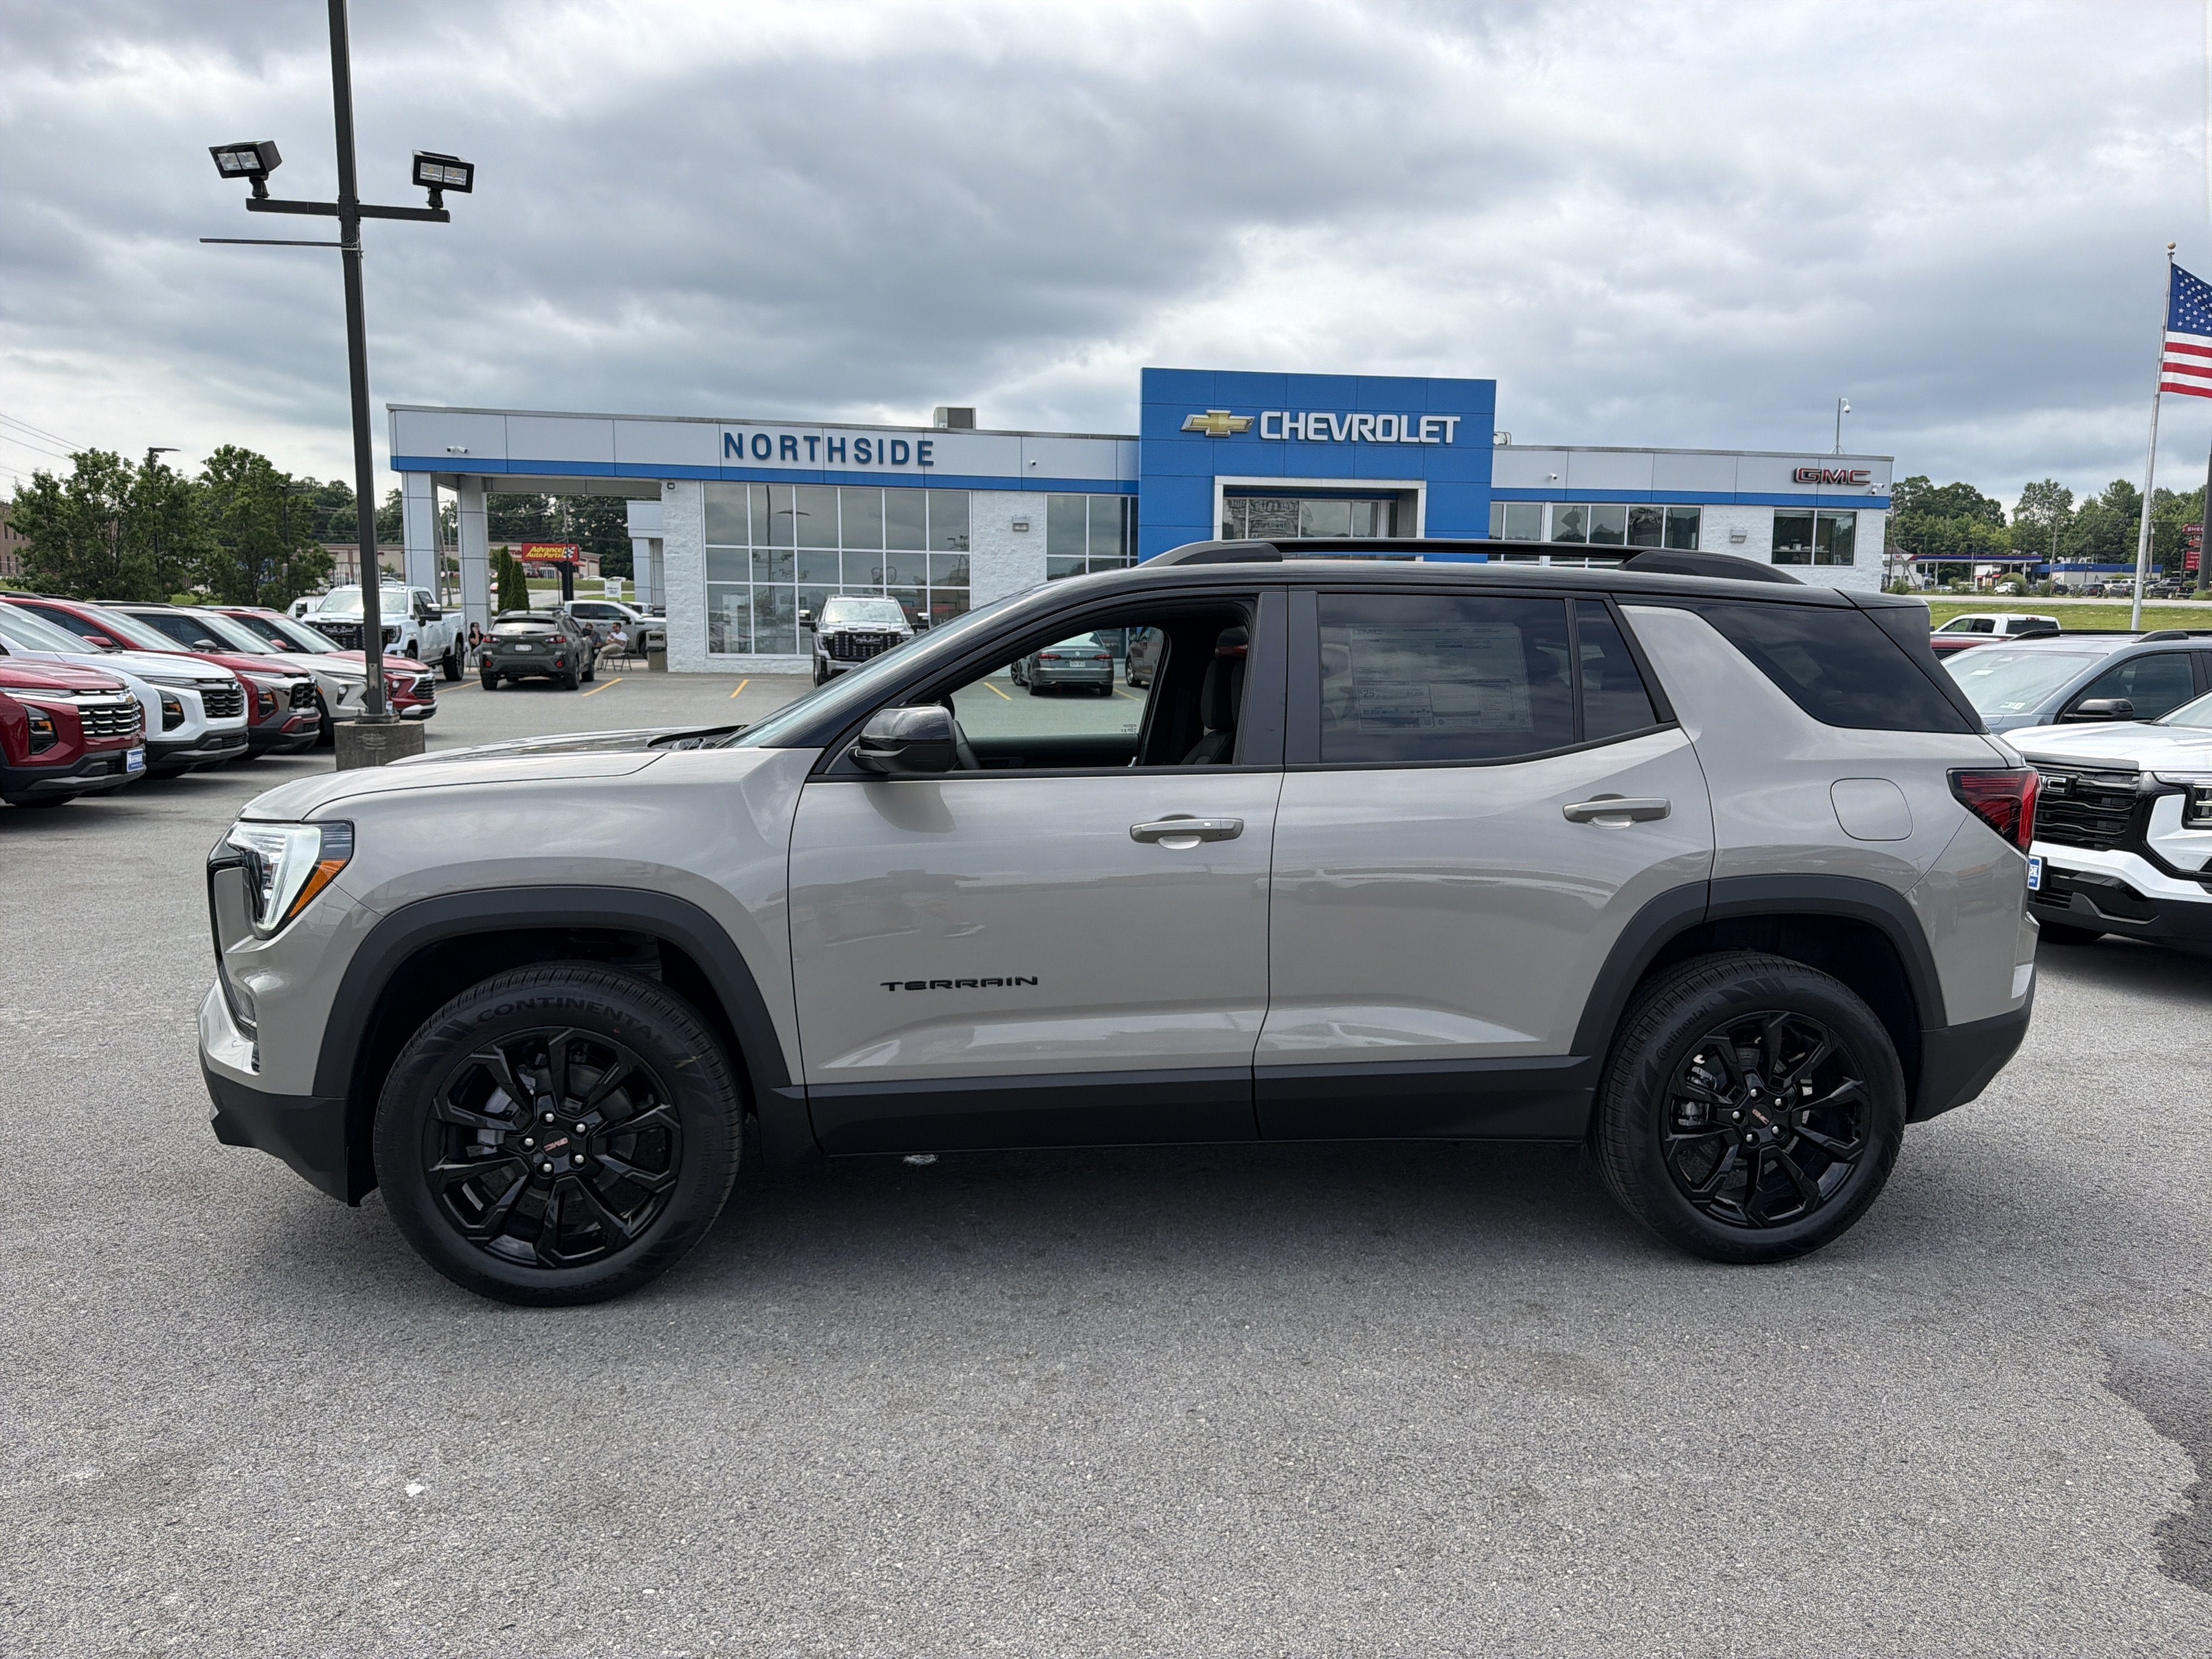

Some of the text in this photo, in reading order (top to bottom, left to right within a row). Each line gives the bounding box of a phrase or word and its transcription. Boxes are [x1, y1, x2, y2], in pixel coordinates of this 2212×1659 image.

[1260, 410, 1462, 444] CHEVROLET
[724, 432, 934, 466] NORTHSIDE
[1794, 467, 1871, 485] GMC
[880, 976, 1038, 991] TERRAIN
[477, 996, 667, 1047] CONTINENTAL
[1656, 1004, 1709, 1060] Continental
[1752, 1108, 1770, 1125] GMC
[544, 1137, 569, 1152] GMC
